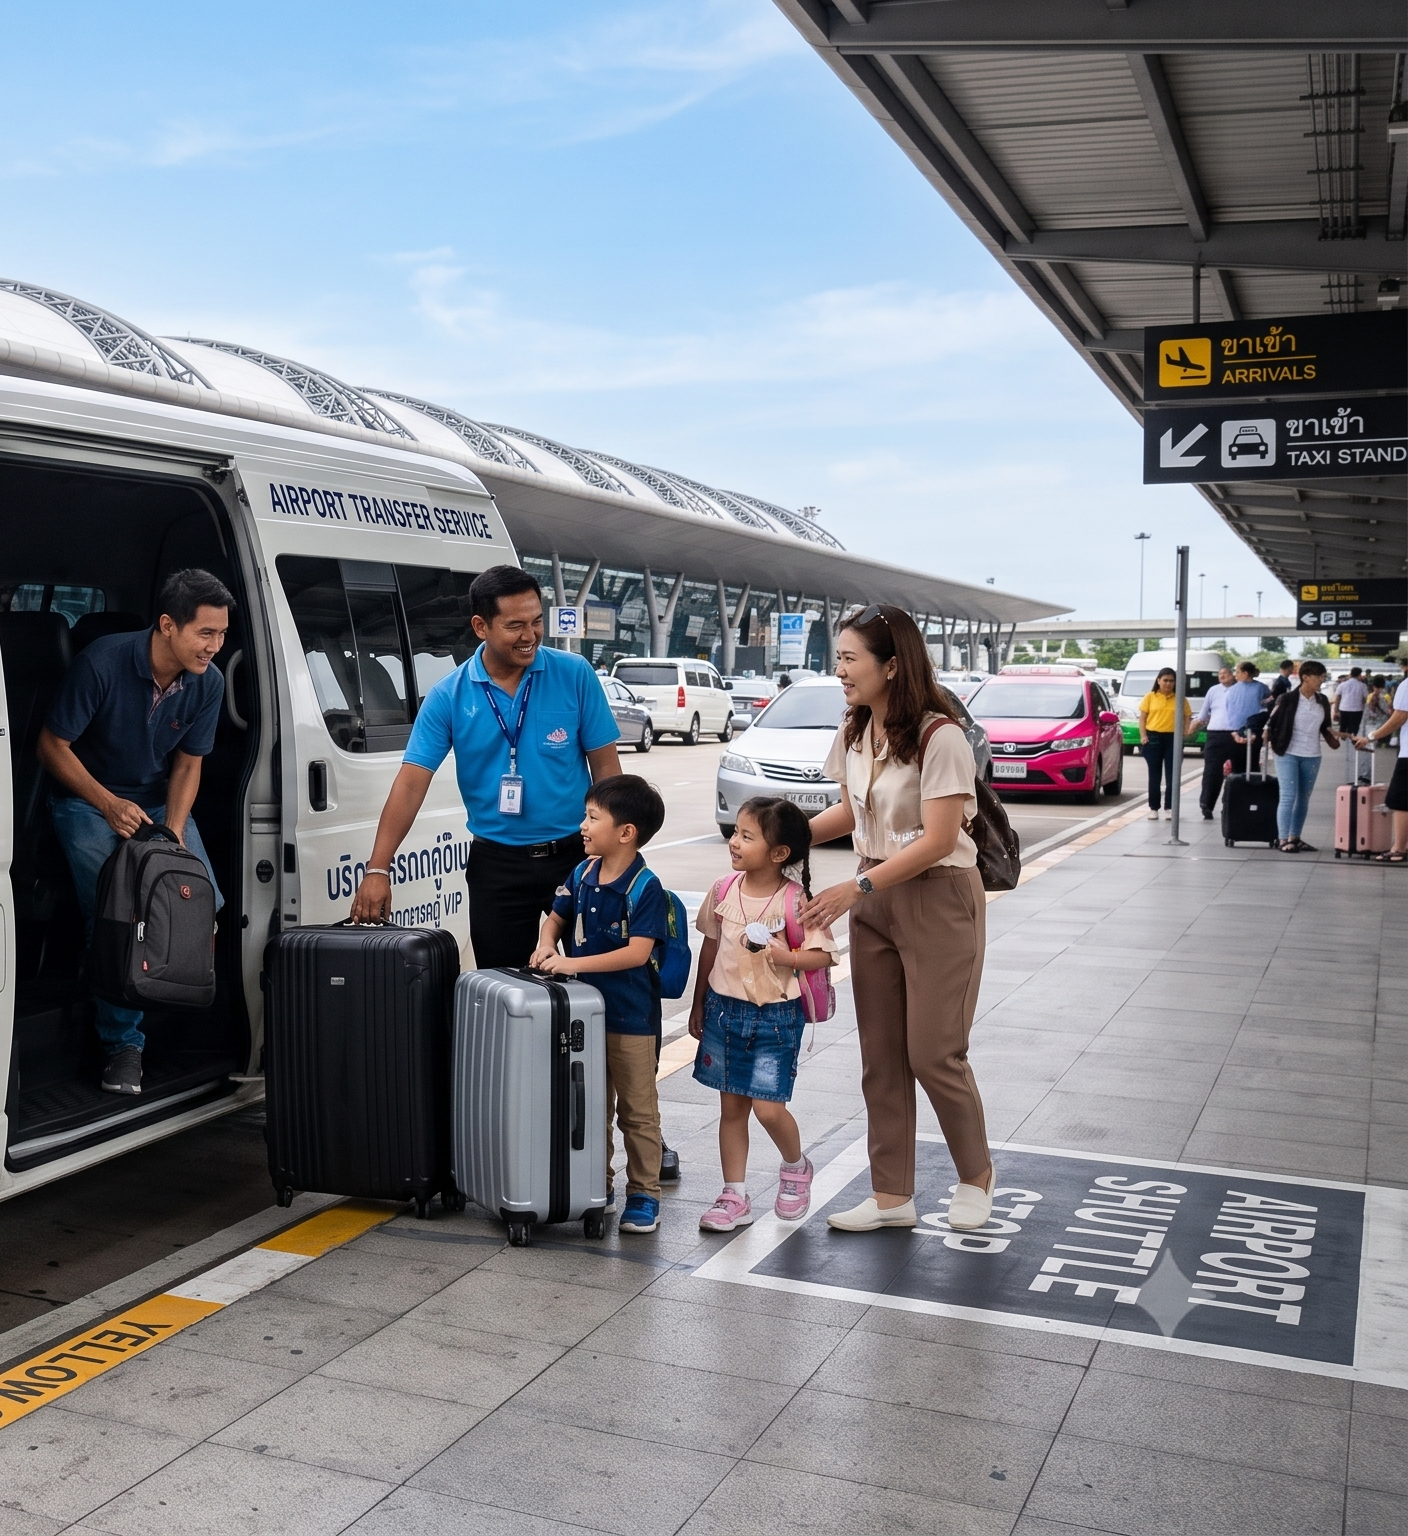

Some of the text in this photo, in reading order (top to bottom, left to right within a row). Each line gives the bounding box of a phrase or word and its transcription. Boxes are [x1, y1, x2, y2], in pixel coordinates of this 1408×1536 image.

[1221, 326, 1296, 355] ขาเข้า
[1222, 365, 1316, 384] ARRIVALS
[1285, 407, 1364, 437] ขาเข้า
[1287, 447, 1407, 466] TAXI STAND
[269, 483, 493, 540] AIRPORT TRANSFER SERVICE
[444, 891, 463, 916] VIP
[1027, 1176, 1188, 1305] SHUTTLE
[1187, 1190, 1319, 1326] AIRPORT
